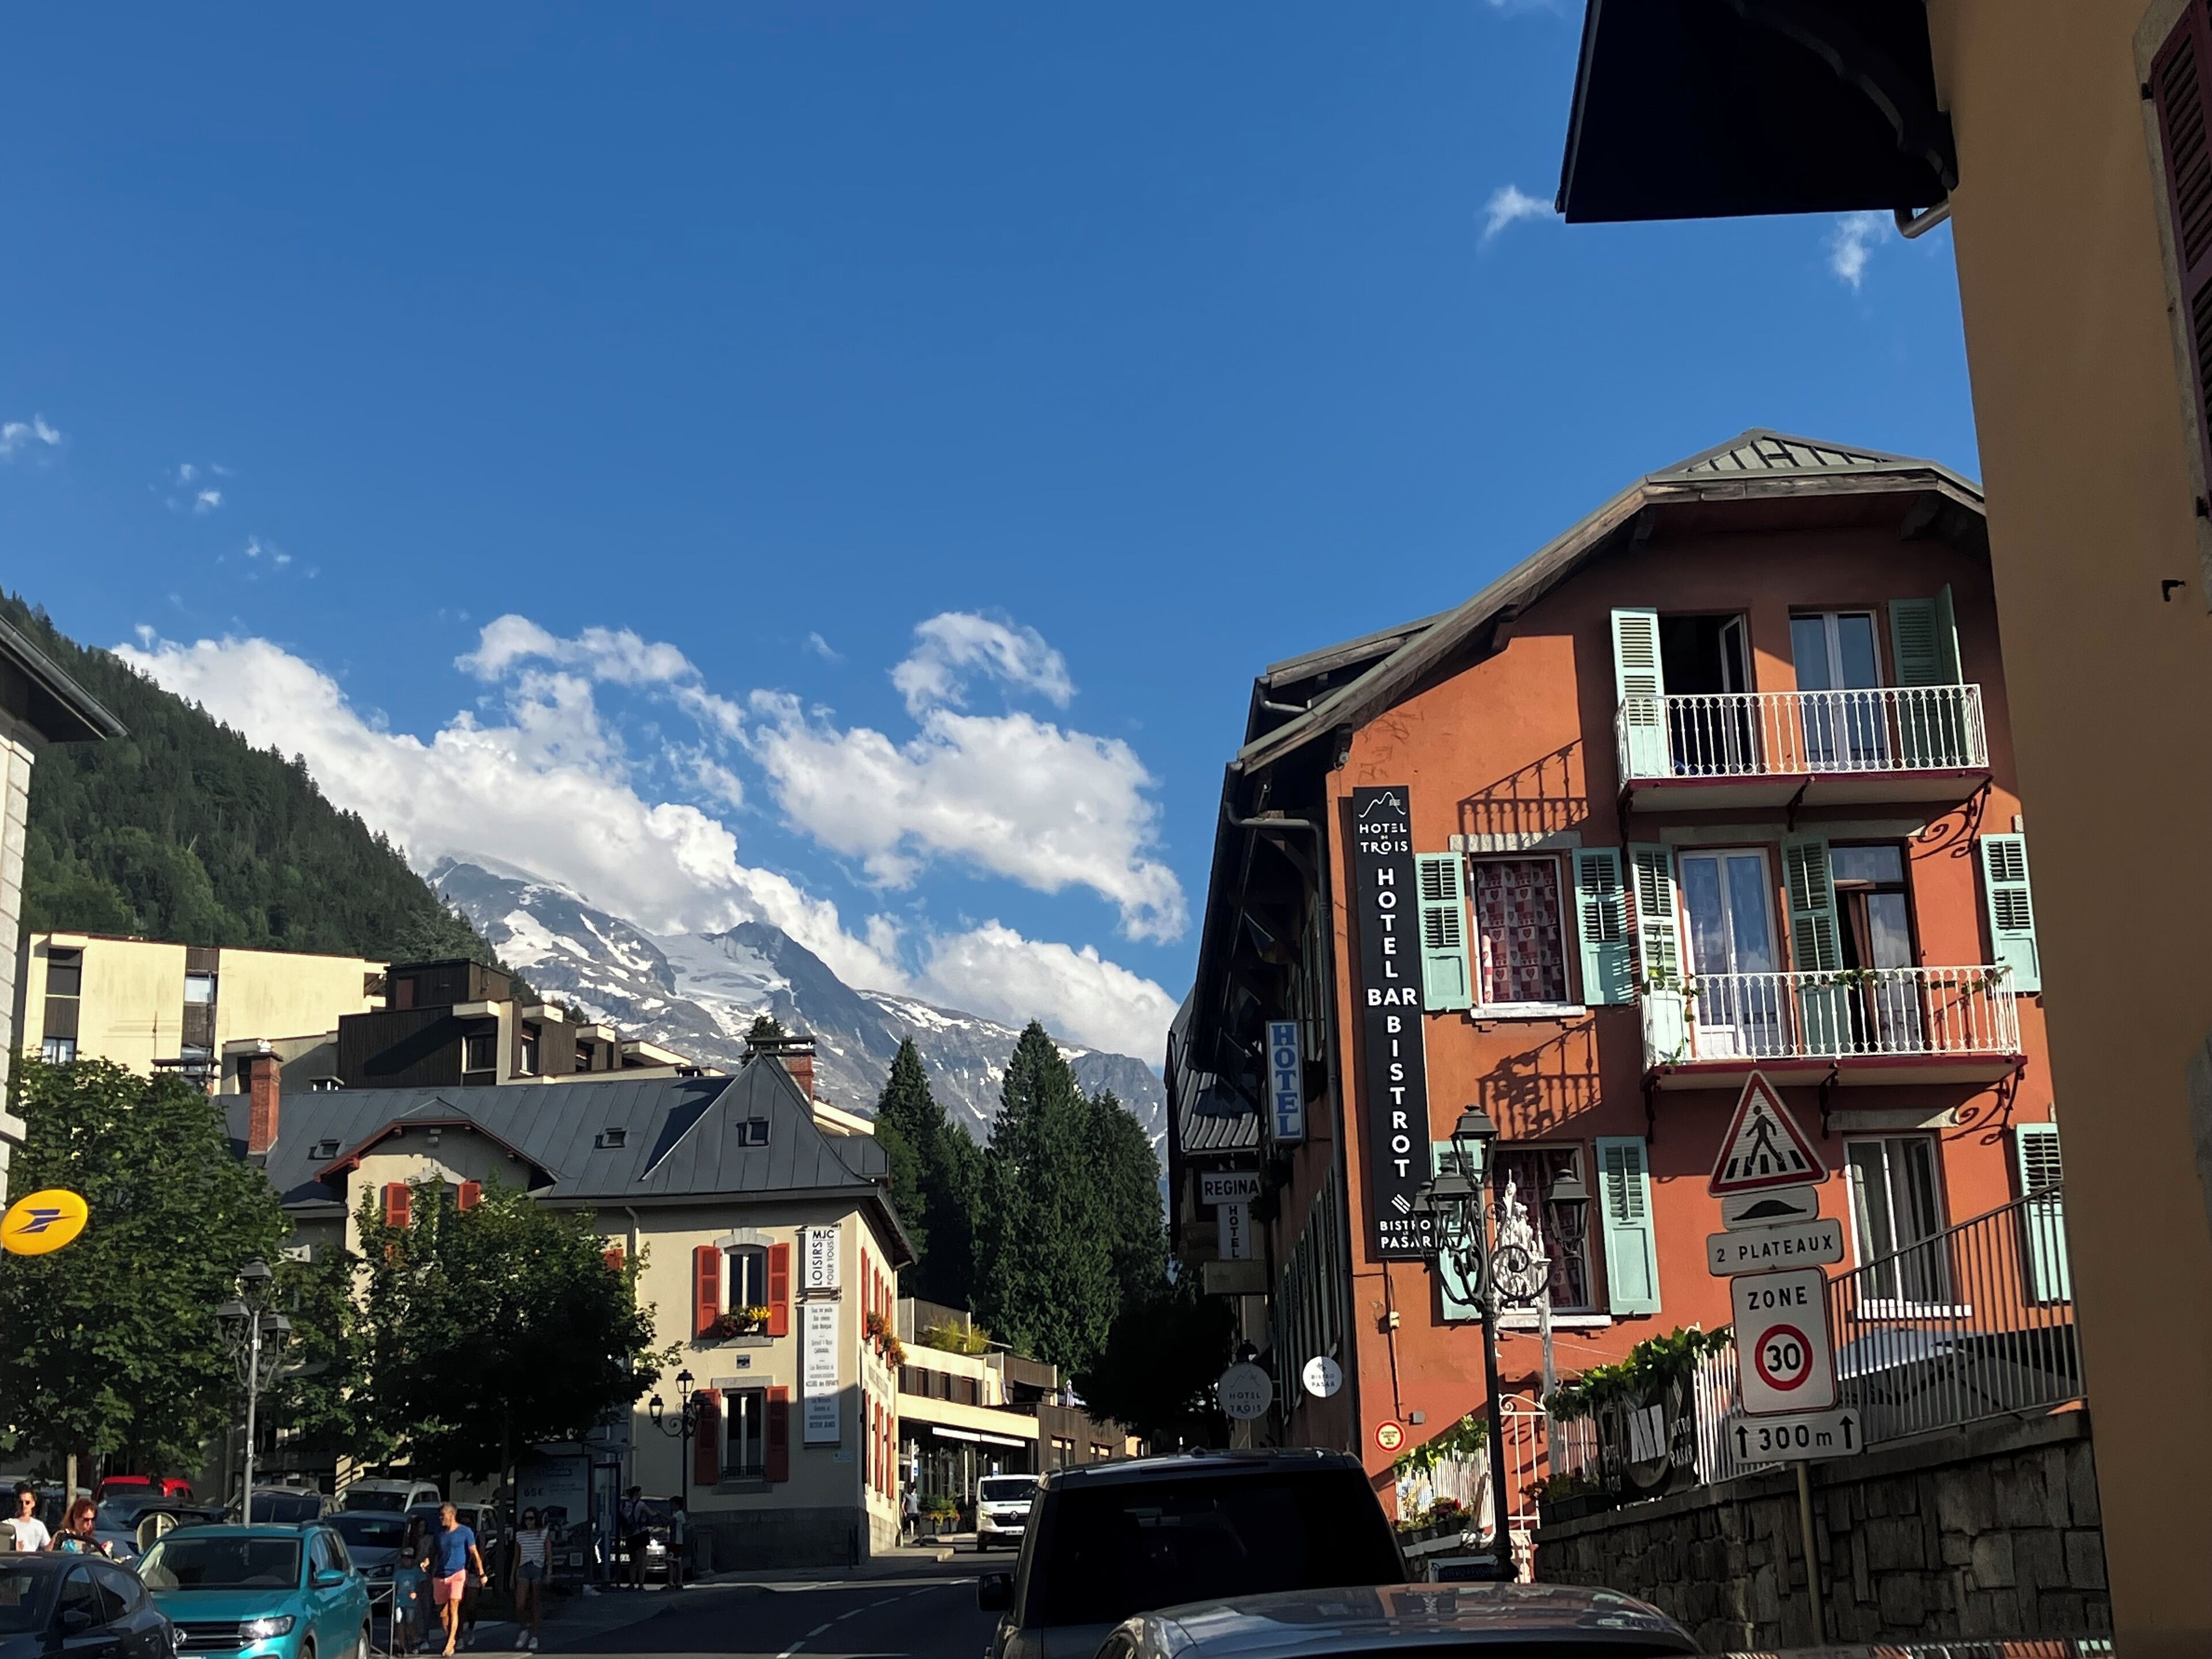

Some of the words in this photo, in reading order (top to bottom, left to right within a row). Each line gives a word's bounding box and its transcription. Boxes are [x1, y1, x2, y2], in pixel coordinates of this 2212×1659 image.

[1359, 823, 1407, 834] HOTEL
[1360, 841, 1408, 855] TROIS
[1377, 868, 1399, 978] HOTEL
[1368, 988, 1418, 1006] BAR
[1271, 1024, 1301, 1137] HOTEL
[1387, 1016, 1411, 1178] BISTROT
[1205, 1179, 1259, 1195] REGINA
[813, 1230, 834, 1239] MJC
[1229, 1205, 1240, 1258] HOTEL
[1717, 1248, 1726, 1263] 2
[1738, 1234, 1834, 1260] PLATEAUX
[812, 1241, 823, 1286] LOISIRS
[1748, 1286, 1808, 1310] ZONE
[1766, 1343, 1801, 1372] 30
[1230, 1405, 1262, 1414] TROIS
[1759, 1425, 1809, 1451] 300
[1816, 1430, 1832, 1446] m
